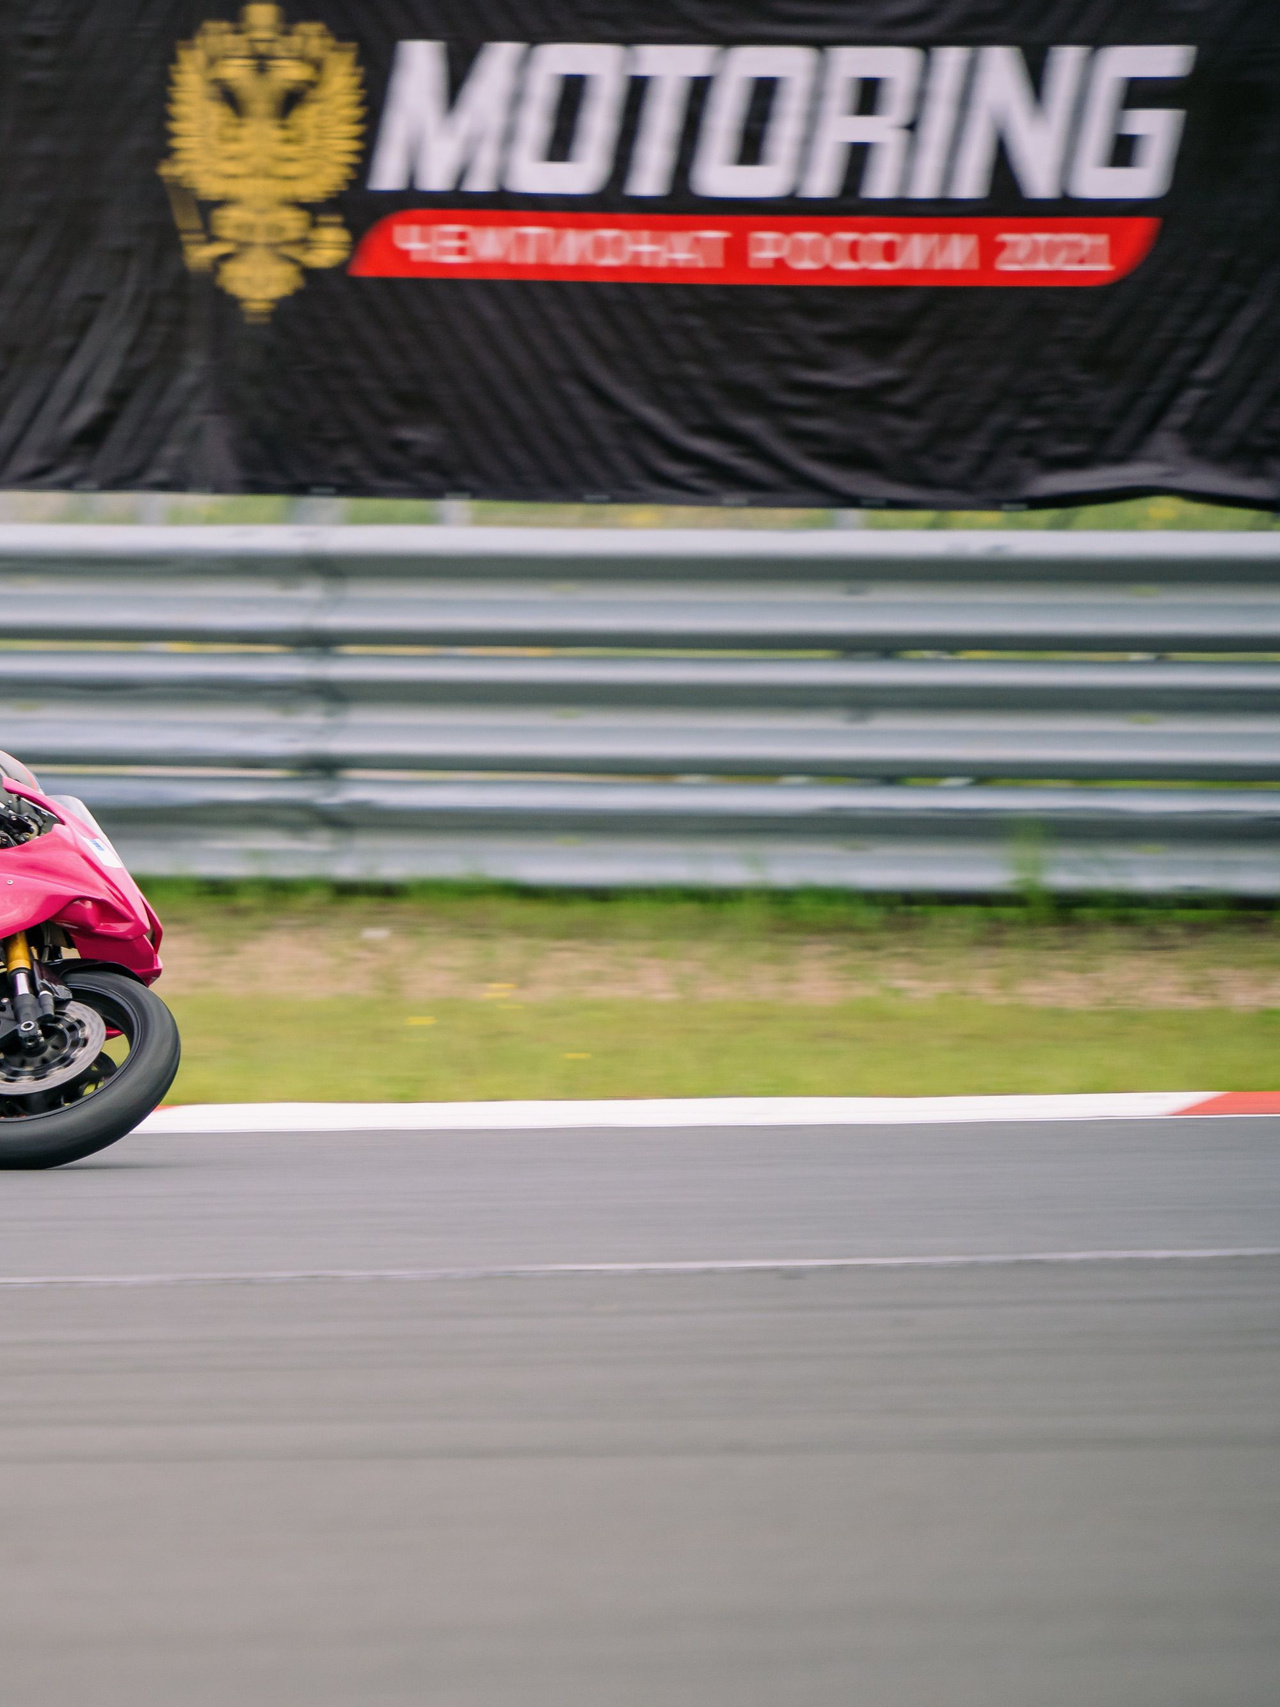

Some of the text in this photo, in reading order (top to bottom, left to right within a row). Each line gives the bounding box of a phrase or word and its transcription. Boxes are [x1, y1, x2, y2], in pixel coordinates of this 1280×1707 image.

[367, 40, 1197, 199] MOTORING
[393, 224, 1116, 271] ЧЕМПИОНАТ РОССИИ 2021
